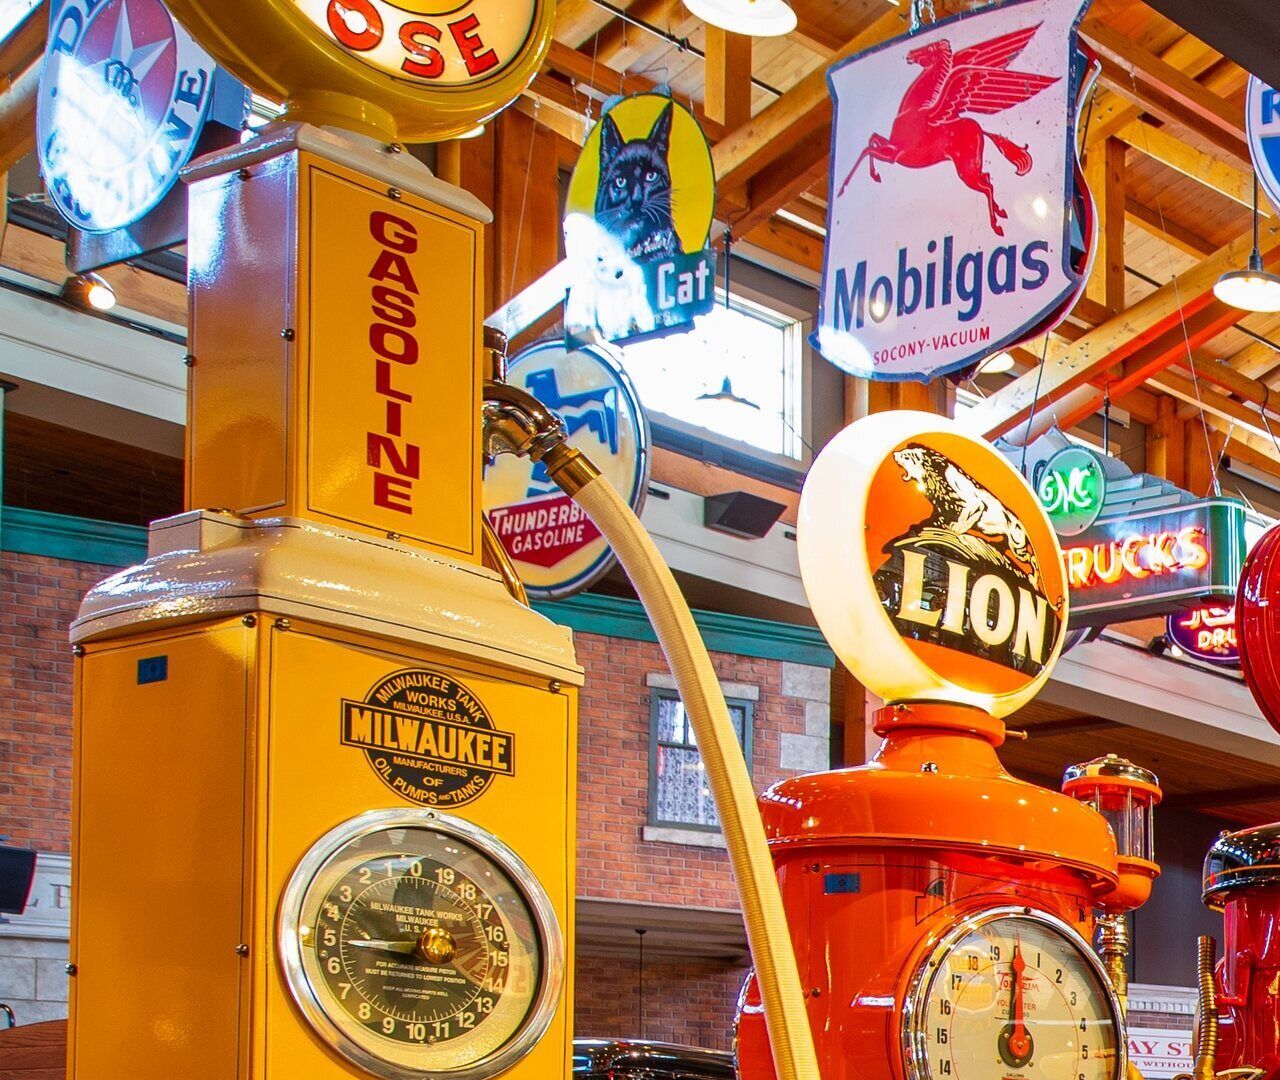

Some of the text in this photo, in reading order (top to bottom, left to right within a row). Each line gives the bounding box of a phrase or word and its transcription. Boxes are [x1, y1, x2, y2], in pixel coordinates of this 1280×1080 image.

[327, 0, 500, 79] OSE
[657, 259, 710, 311] Cat
[833, 235, 1050, 333] Mobilgas
[873, 326, 991, 367] SOCONY-VACUUM
[368, 211, 420, 515] GASOLINE
[511, 524, 585, 554] GASOLINE
[896, 549, 1049, 665] LION
[375, 674, 485, 723] MILWAUKEE TANK
[405, 690, 457, 712] WORKS
[350, 706, 508, 770] MILWAUKEE
[393, 756, 468, 778] MANUFACTURERS
[374, 757, 391, 781] OIL
[393, 777, 438, 804] PUMPS
[450, 775, 485, 803] TANKS
[422, 776, 444, 788] OF
[435, 868, 455, 885] 19
[370, 901, 463, 922] MILWAUKEE TANK WORKS
[396, 914, 439, 927] MILWAUKEE
[474, 904, 493, 920] 17
[485, 926, 504, 942] 16
[474, 997, 493, 1014] 13
[456, 1012, 475, 1028] 12
[405, 1023, 426, 1040] 10
